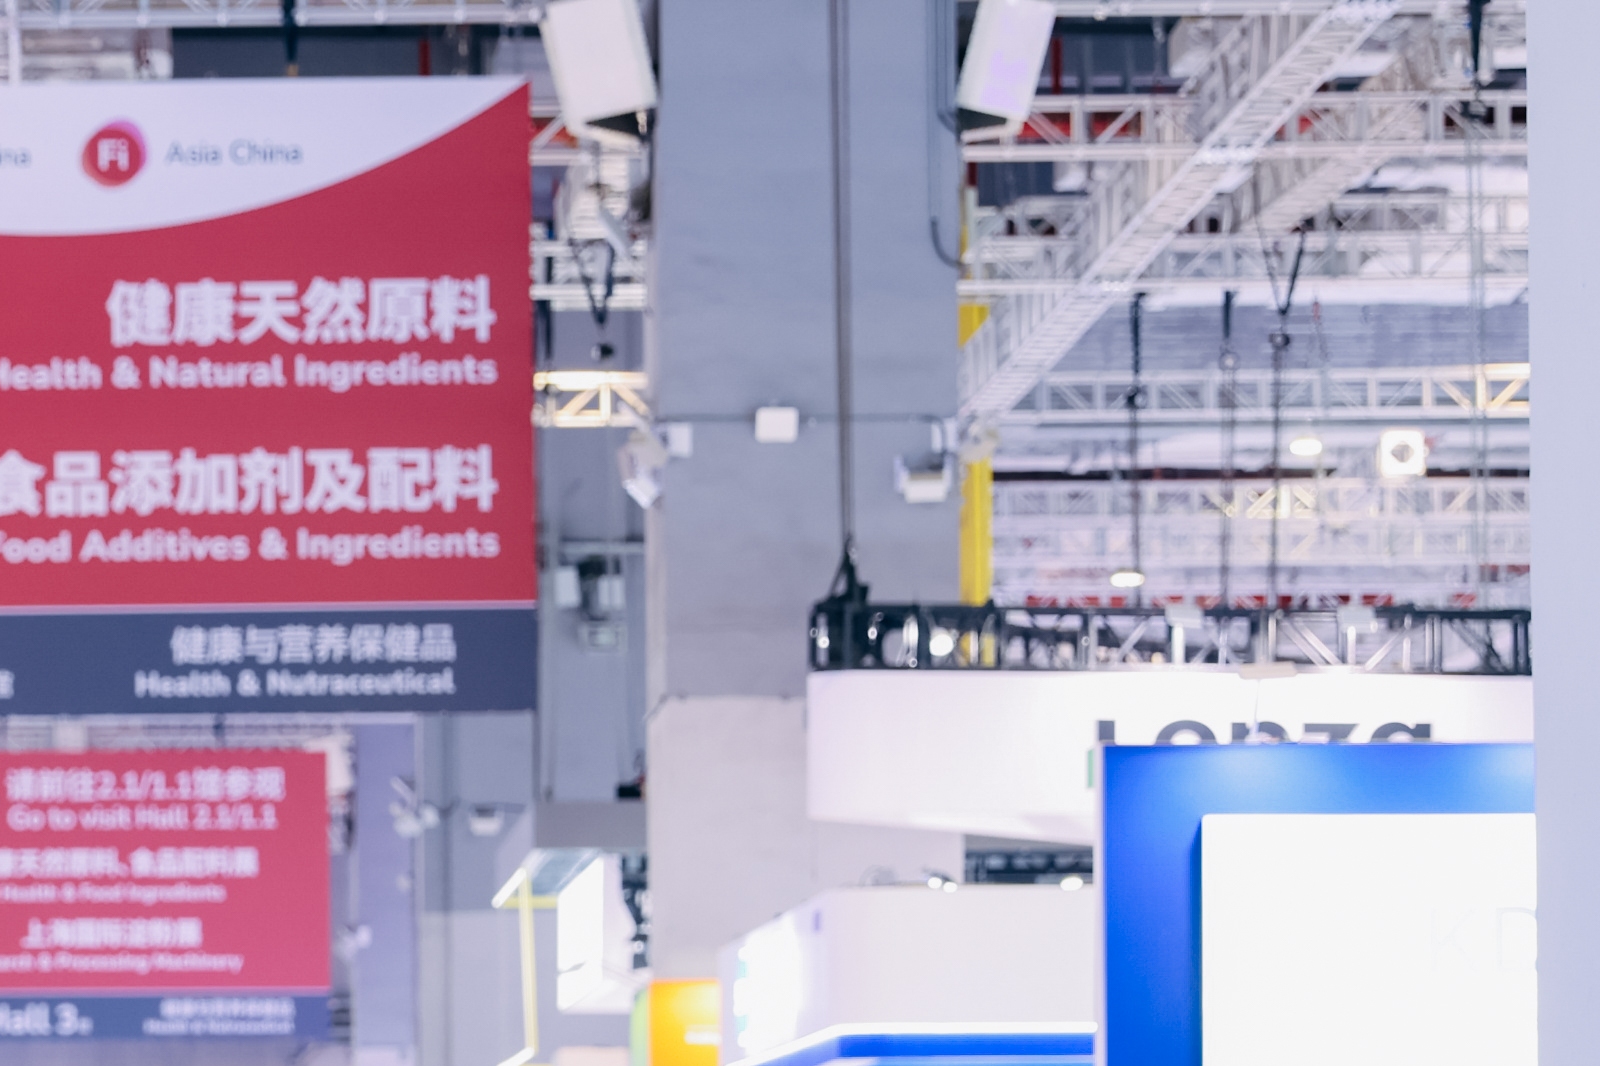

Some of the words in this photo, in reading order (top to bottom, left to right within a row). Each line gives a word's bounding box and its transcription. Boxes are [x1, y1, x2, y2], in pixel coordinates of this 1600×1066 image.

[98, 137, 130, 173] Fi
[166, 141, 222, 165] Asia
[229, 139, 303, 165] China
[106, 274, 496, 347] 健康天然原料
[111, 355, 140, 390] &
[148, 353, 286, 389] Natural
[294, 352, 498, 393] Ingredients
[79, 527, 250, 563] Additives
[258, 527, 288, 560] &
[296, 525, 499, 566] Ingredients
[134, 669, 231, 698] Health
[237, 668, 262, 697] &
[266, 667, 456, 696] Nutraceutical
[6, 803, 46, 831] Go
[48, 804, 77, 831] to
[79, 803, 131, 831] visit
[135, 803, 189, 830] Hall
[192, 802, 279, 831] 2.1/1.1
